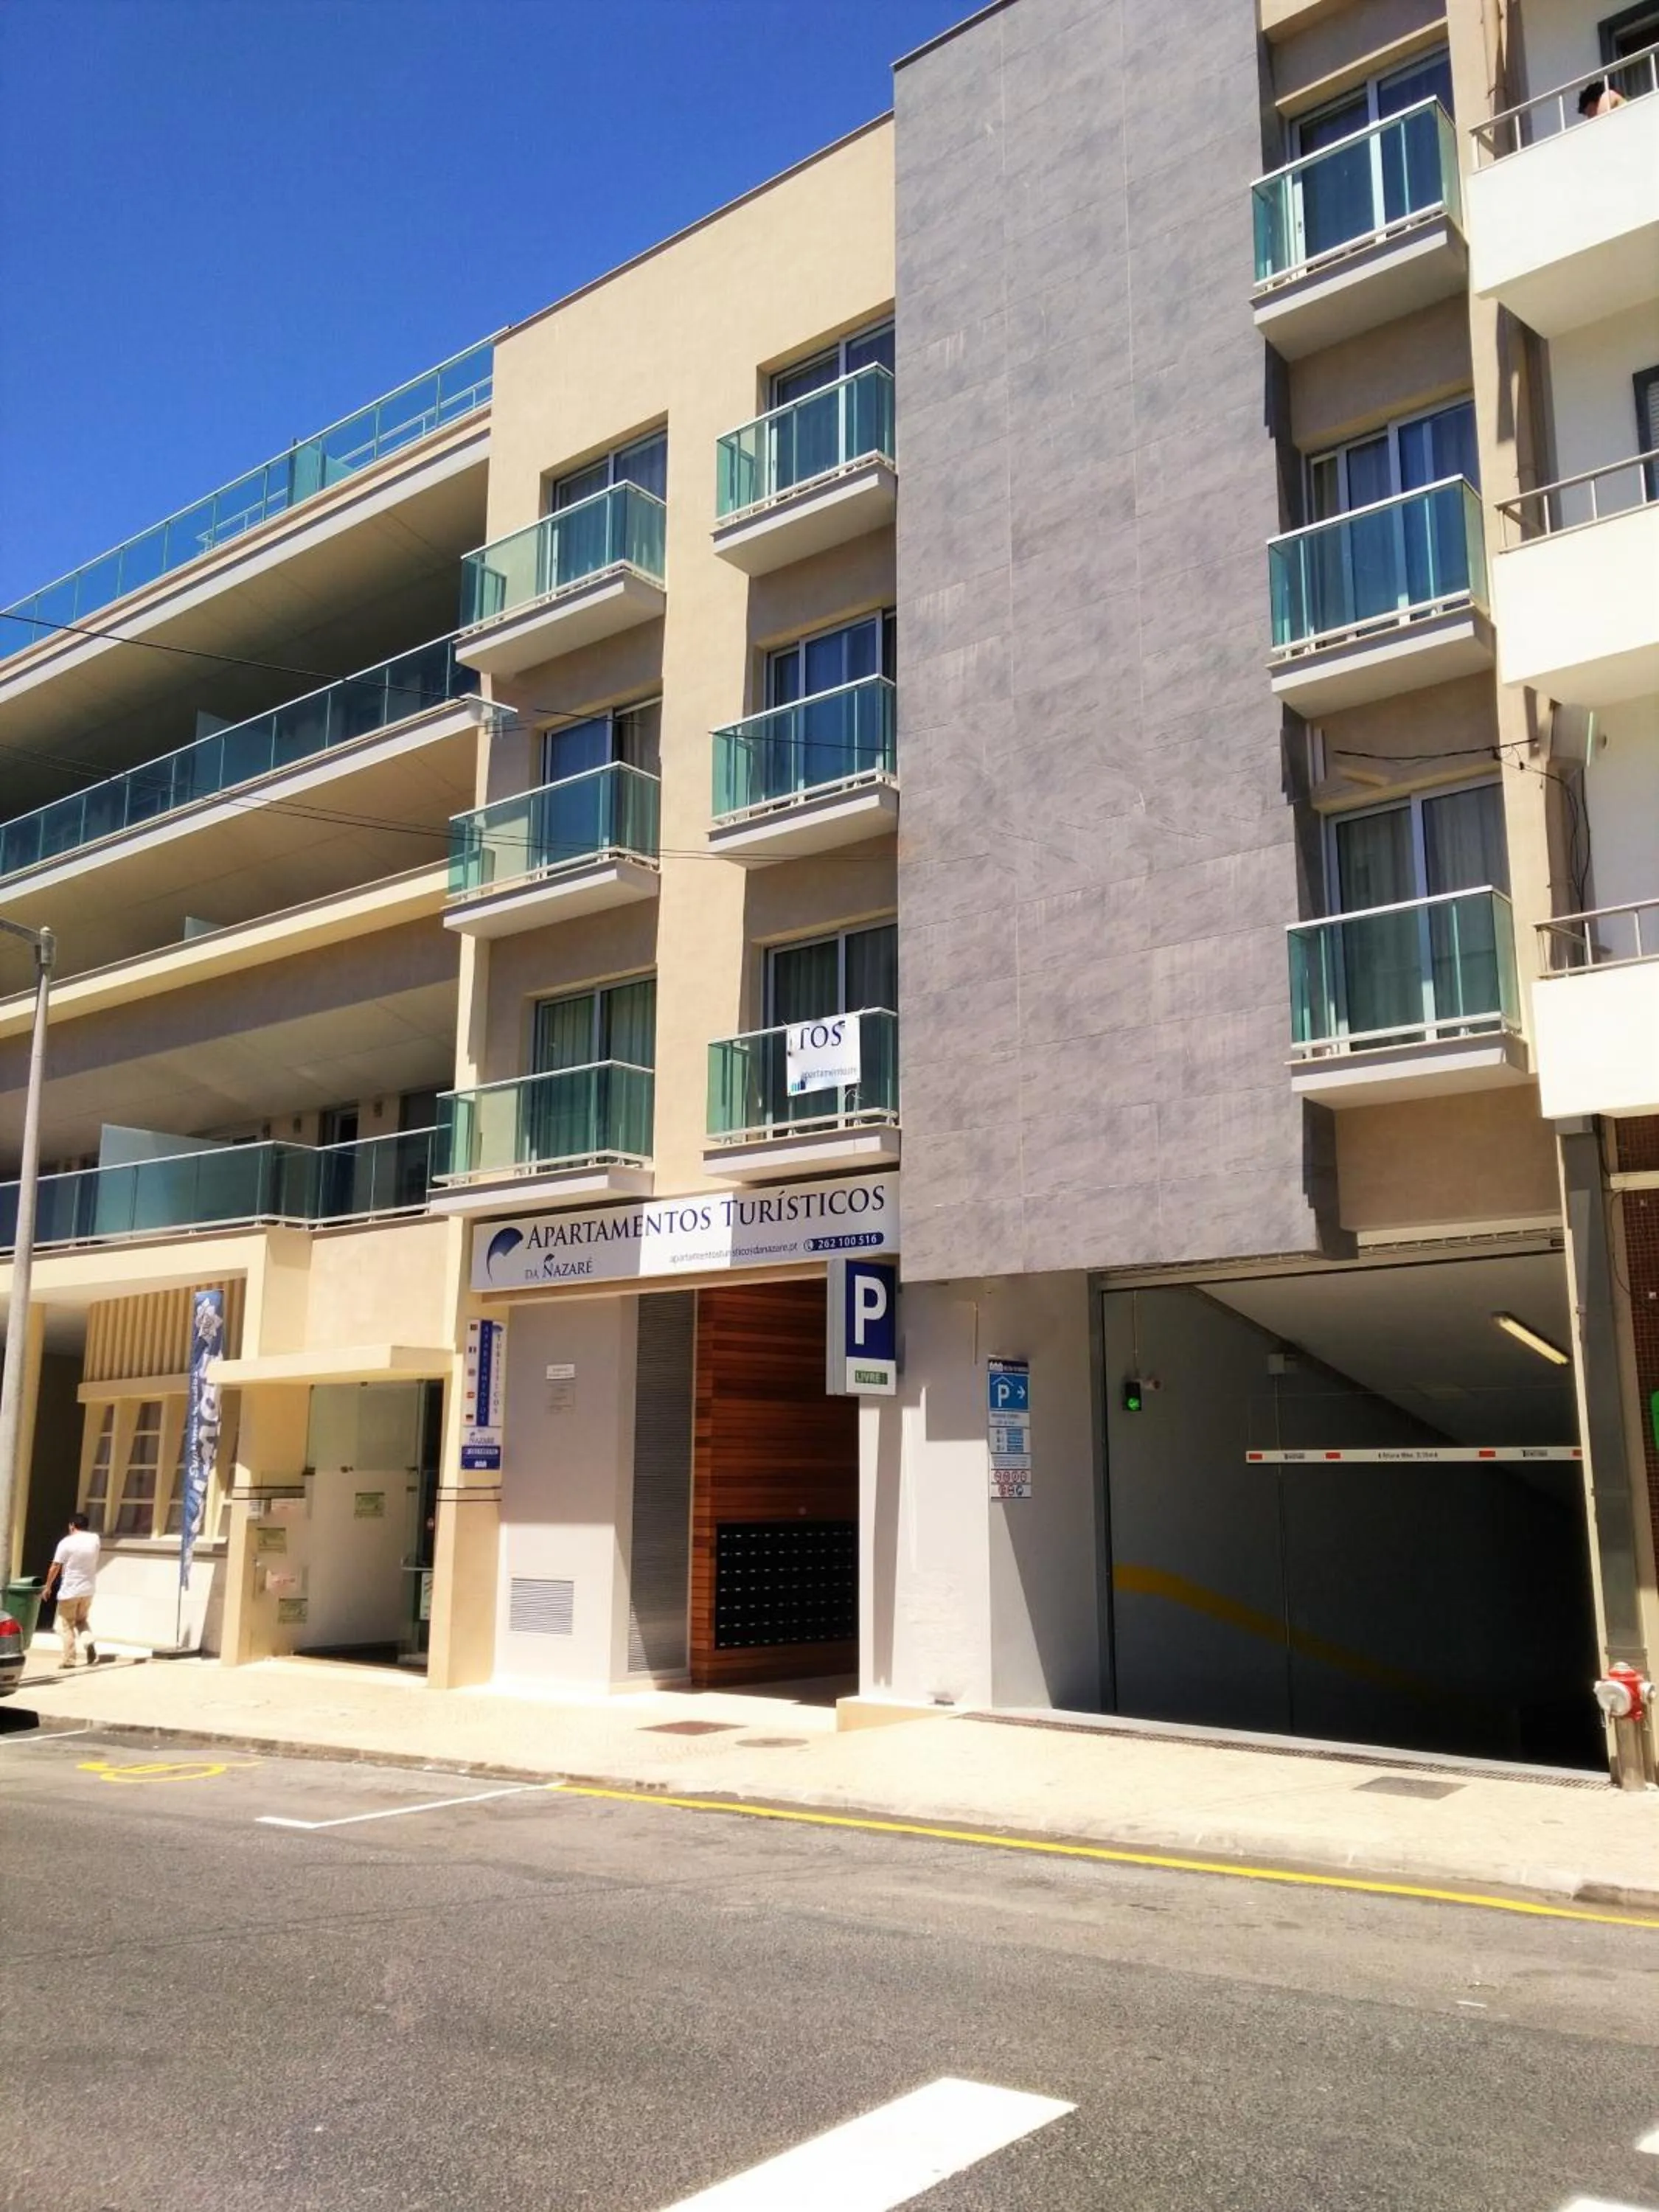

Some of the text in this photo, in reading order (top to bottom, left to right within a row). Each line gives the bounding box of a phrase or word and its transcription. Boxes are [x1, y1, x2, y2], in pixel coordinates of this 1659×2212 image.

[526, 1184, 885, 1250] APARTAMENTOS TURÍSTICOS
[818, 1234, 877, 1249] 262 100 516
[524, 1256, 594, 1280] DA NAZARÉ
[855, 1275, 887, 1345] P
[998, 1384, 1010, 1408] P
